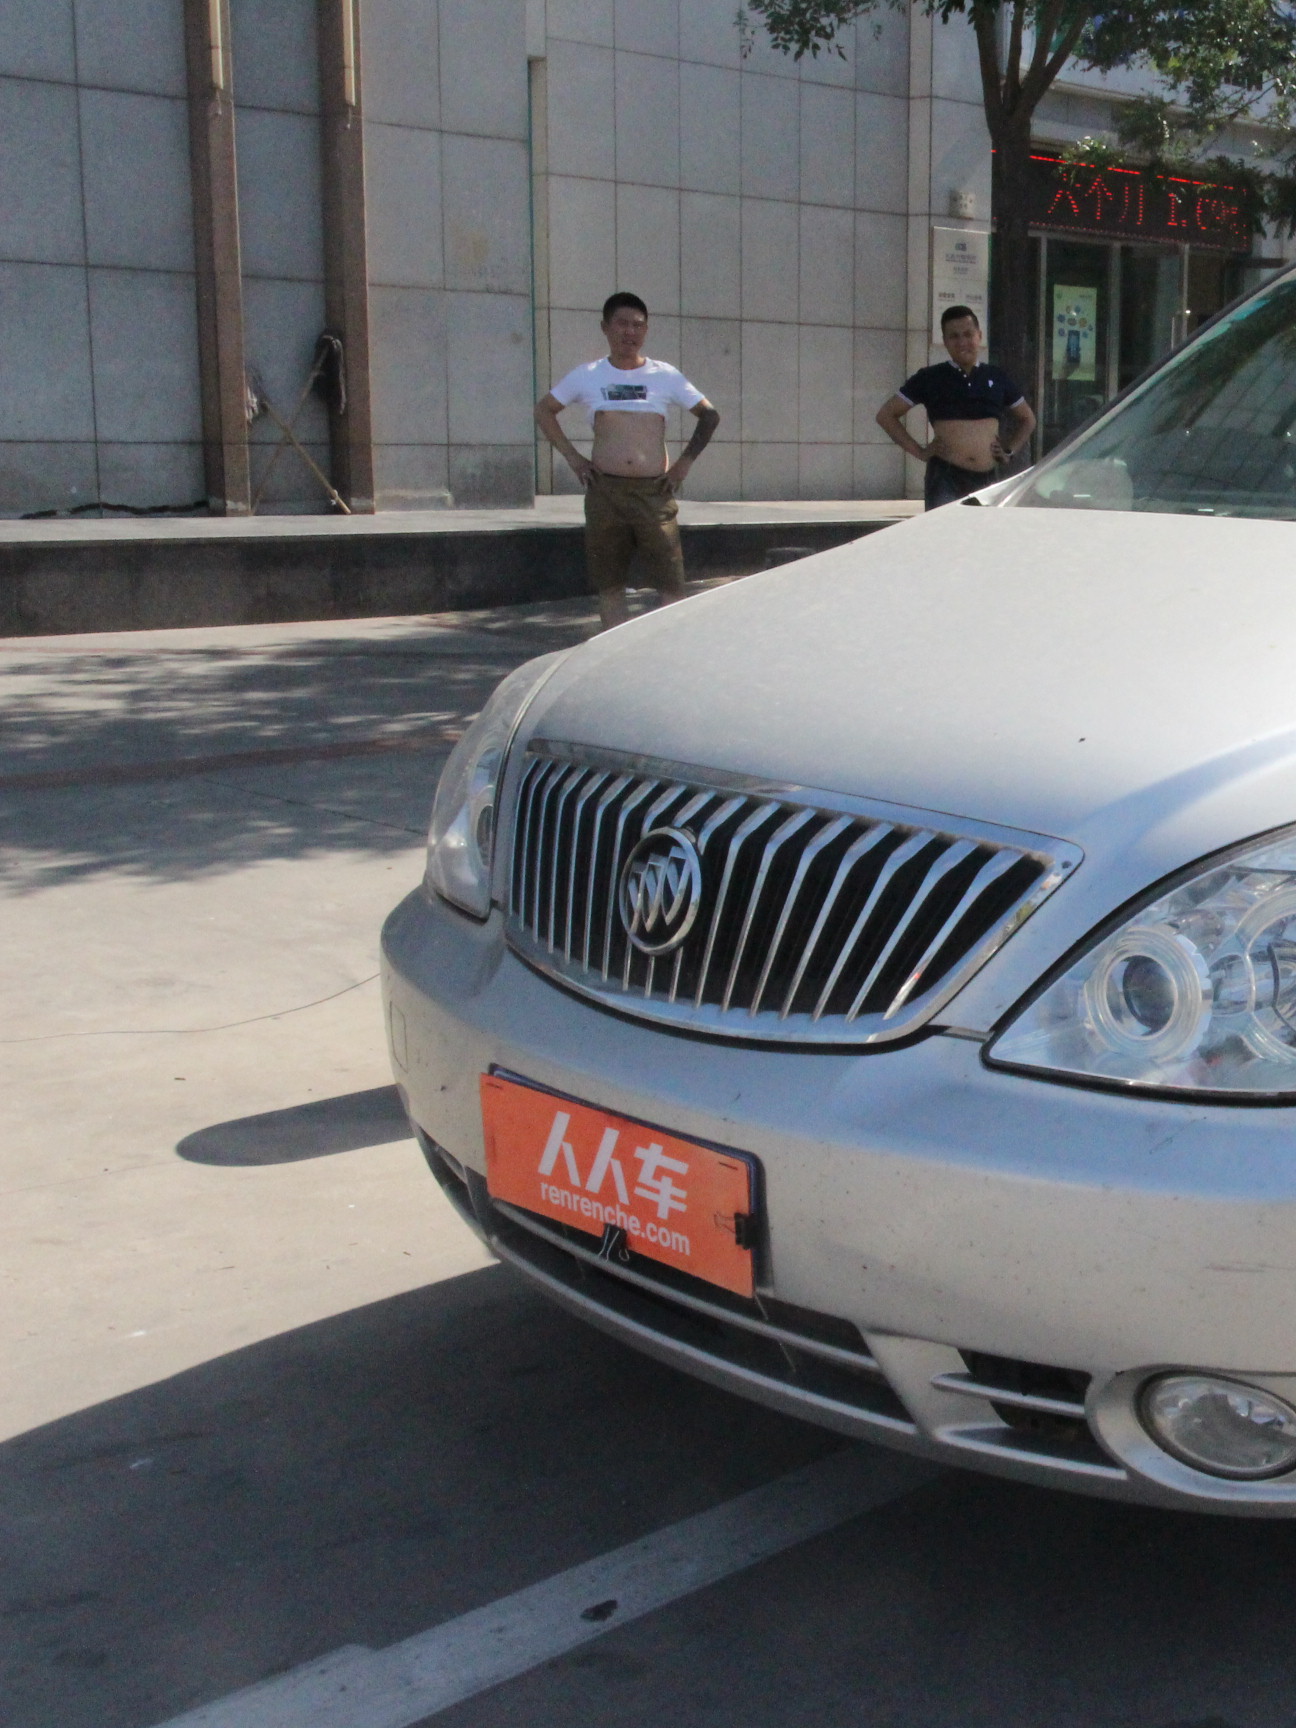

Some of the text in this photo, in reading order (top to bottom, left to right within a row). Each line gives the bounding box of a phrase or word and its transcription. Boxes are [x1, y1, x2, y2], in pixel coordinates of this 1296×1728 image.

[537, 1110, 690, 1220] 人人车
[540, 1180, 691, 1256] renrenche.com
